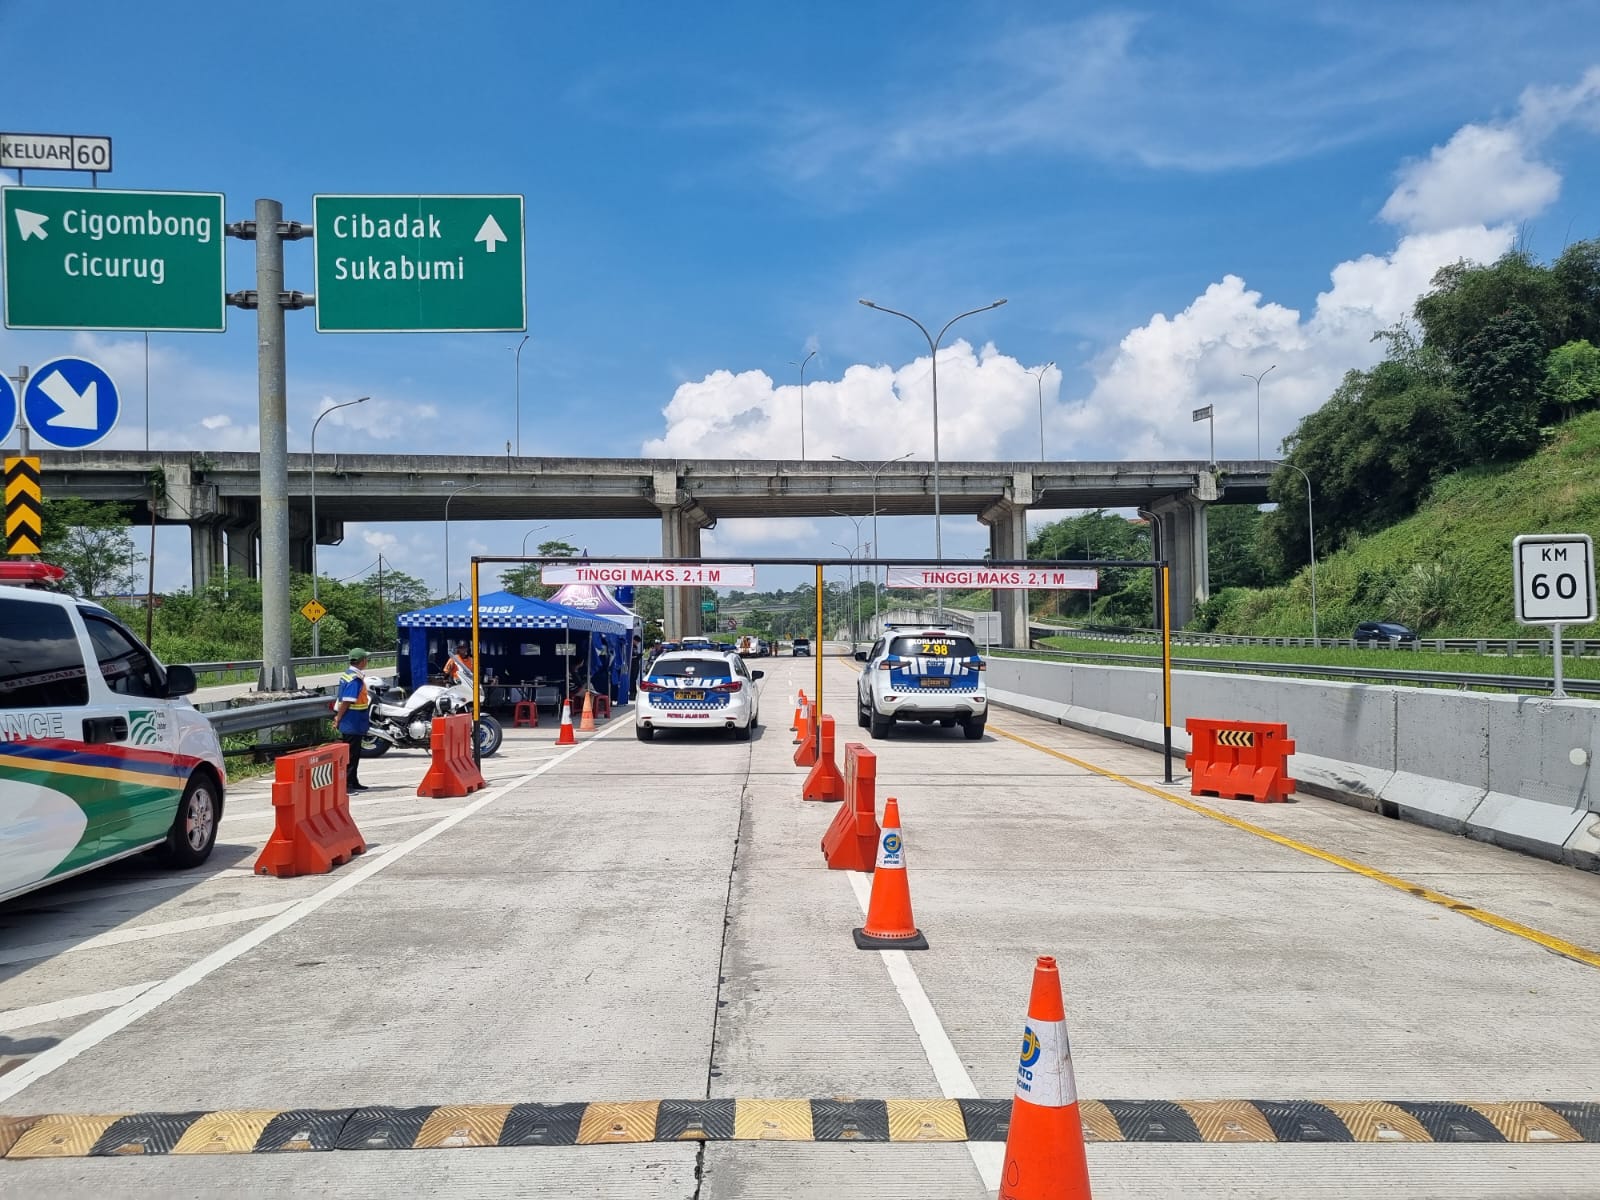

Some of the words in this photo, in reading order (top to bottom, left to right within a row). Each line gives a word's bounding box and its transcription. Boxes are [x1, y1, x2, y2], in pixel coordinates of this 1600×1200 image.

[1, 142, 71, 161] KELUAR
[77, 144, 106, 165] 60
[63, 209, 211, 243] Cigombong
[333, 213, 442, 239] Cibadak
[64, 252, 165, 285] Cicurug
[335, 256, 464, 280] Sukabumi
[1541, 547, 1567, 561] KM
[576, 569, 626, 582] TINGGI
[631, 570, 678, 582] MAKS.
[683, 570, 703, 583] 2,1
[709, 570, 720, 582] M
[922, 572, 972, 584] TINGGI
[977, 573, 1023, 585] MAKS.
[1028, 573, 1047, 586] 2,1
[1053, 573, 1065, 585] M
[1531, 573, 1577, 600] 60
